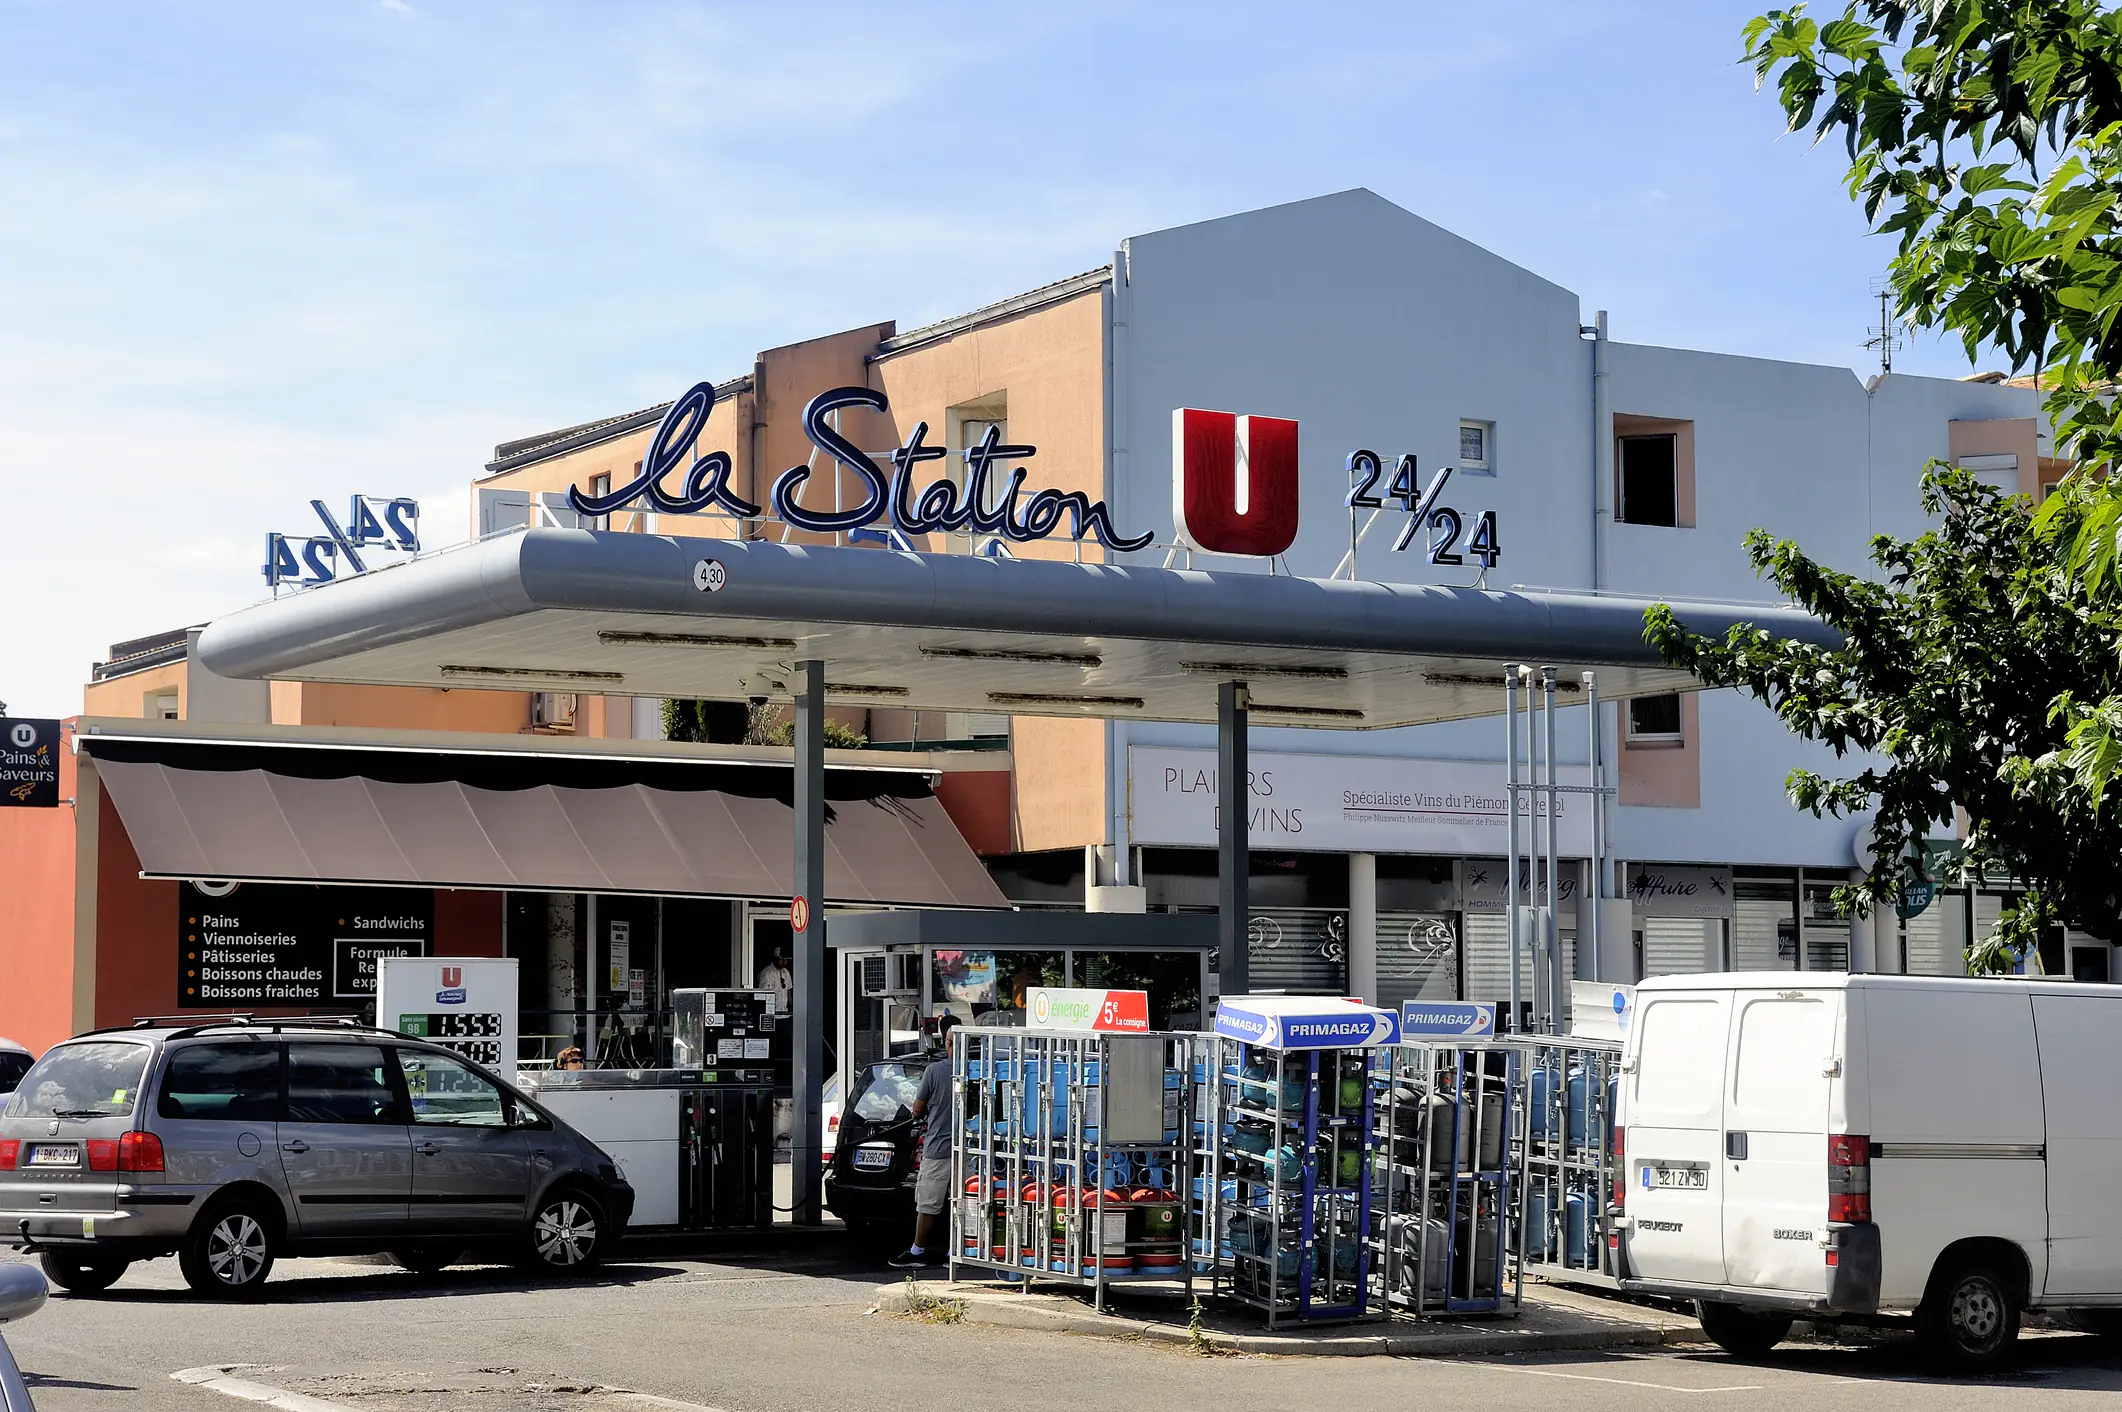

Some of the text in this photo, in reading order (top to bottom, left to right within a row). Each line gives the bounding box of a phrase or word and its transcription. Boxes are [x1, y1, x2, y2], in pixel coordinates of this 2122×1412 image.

[565, 381, 761, 516] la
[771, 386, 1154, 552] Station
[1172, 407, 1300, 559] U
[700, 568, 723, 584] 4.30
[41, 754, 50, 766] &
[0, 768, 54, 782] aveurs
[1165, 768, 1273, 796] PLAIRS
[1343, 789, 1411, 807] Spécialiste
[1413, 793, 1442, 808] Vins
[1445, 794, 1461, 808] du
[1464, 794, 1509, 811] Piémon
[1475, 816, 1485, 826] de
[203, 914, 240, 928] Pains
[354, 916, 425, 929] Sandwichs
[203, 932, 297, 946] Viennoiseries
[202, 949, 276, 963] Pâtisseries
[350, 946, 408, 959] Formule
[202, 966, 322, 981] Boissons chaudes
[441, 967, 462, 987] U
[201, 984, 319, 998] Boissons fraiches
[1051, 998, 1090, 1023] énergie
[441, 1013, 501, 1037] 1.559
[1115, 1017, 1146, 1029] La consigne
[1217, 1014, 1264, 1035] PRIMAGAZ
[1407, 1013, 1472, 1026] PRIMAGAZ
[407, 1023, 420, 1034] 98
[1290, 1022, 1370, 1037] PRIMAGAZ
[1659, 1171, 1676, 1185] 521
[1678, 1171, 1691, 1186] ZW
[1637, 1219, 1683, 1233] PEUGEOT
[1773, 1228, 1813, 1241] BOXER
